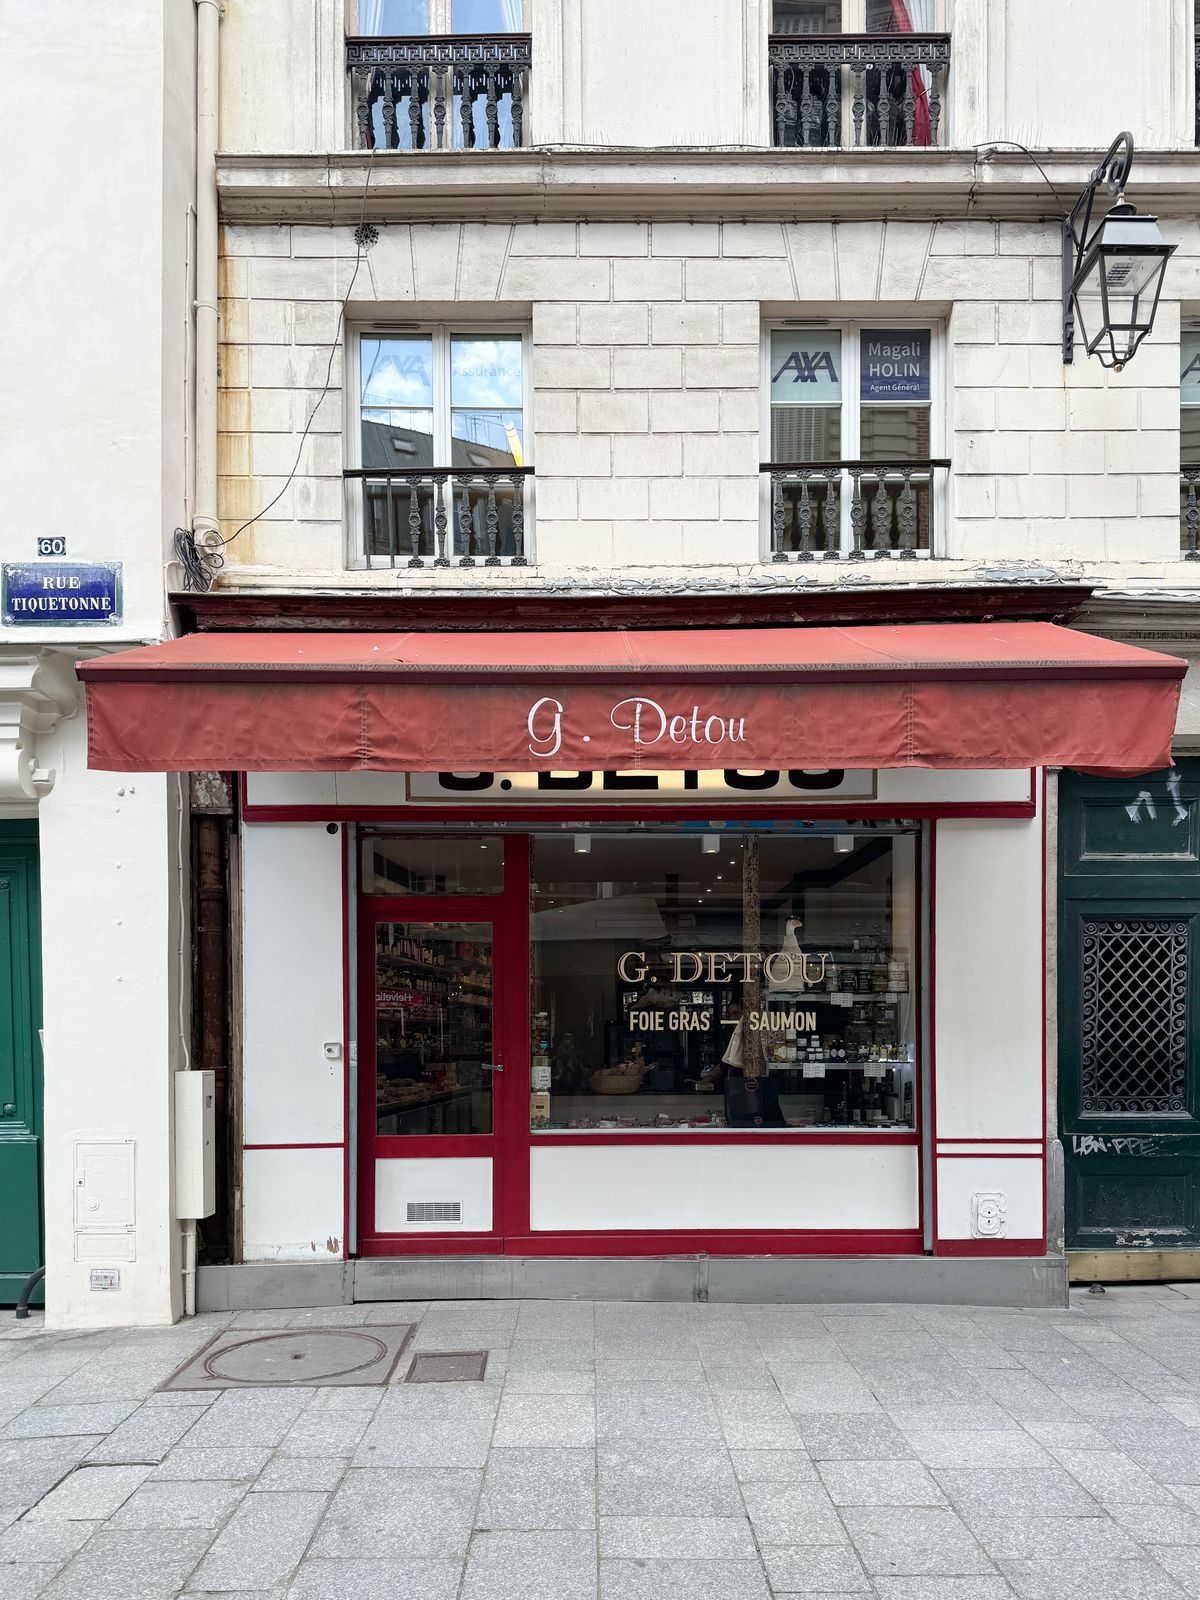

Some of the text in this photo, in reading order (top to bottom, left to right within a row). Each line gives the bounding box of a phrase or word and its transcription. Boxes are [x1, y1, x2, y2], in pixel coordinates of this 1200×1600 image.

[868, 342, 921, 361] Magali
[771, 351, 839, 383] AXA
[868, 363, 920, 377] HOLIN
[870, 383, 920, 393] Agent Général
[40, 539, 64, 554] 60
[42, 576, 81, 590] RUE
[12, 597, 112, 613] TIQUETONNE
[610, 697, 747, 745] Detou
[617, 951, 829, 983] G. DETOU
[630, 1011, 664, 1031] FOIE
[669, 1011, 710, 1031] GRAS
[749, 1011, 817, 1031] SAUMON
